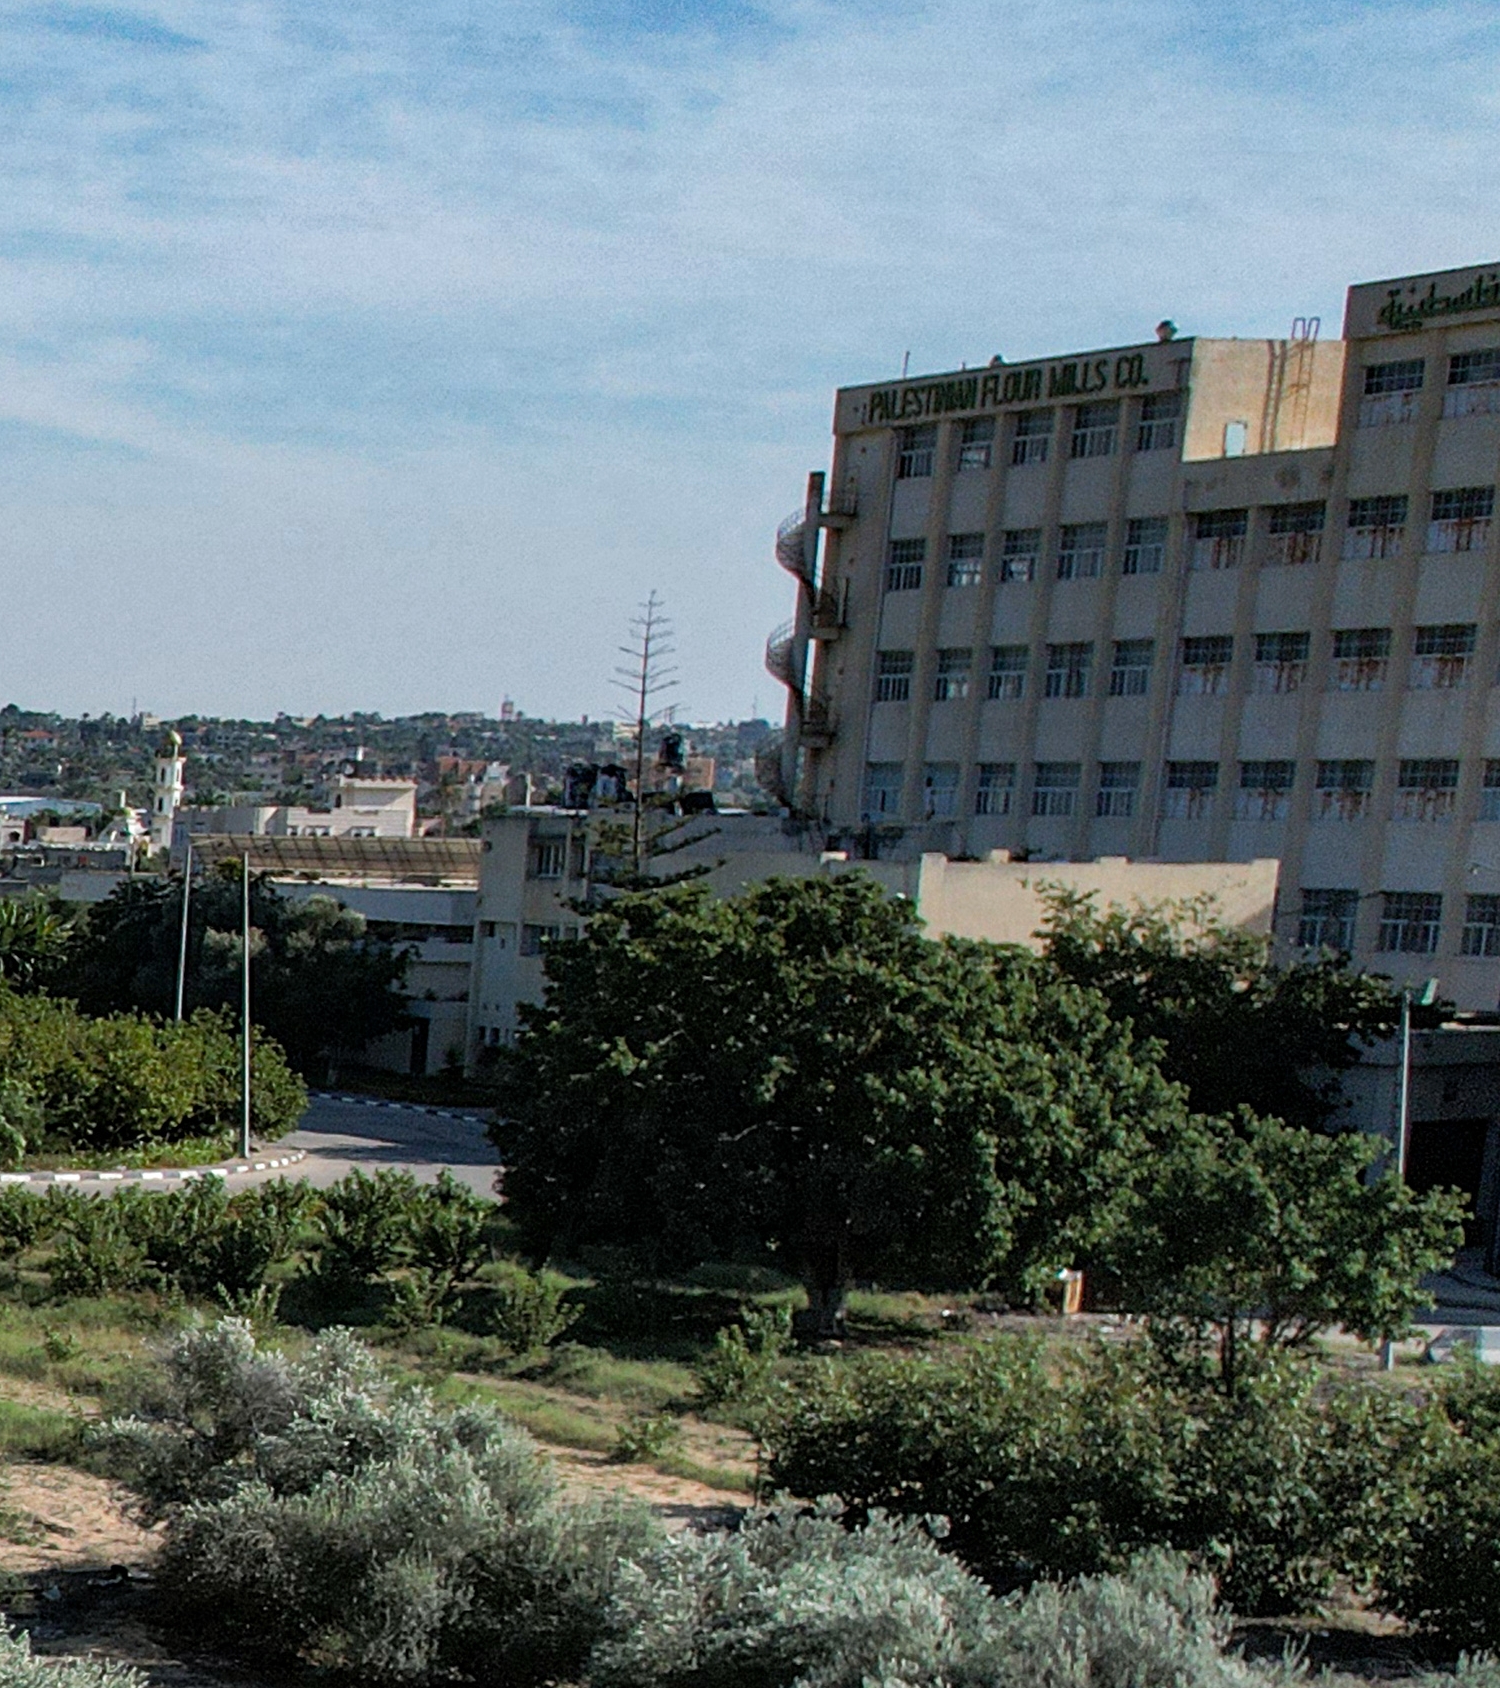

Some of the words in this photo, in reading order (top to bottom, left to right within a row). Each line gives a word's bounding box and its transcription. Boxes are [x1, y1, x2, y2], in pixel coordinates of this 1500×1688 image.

[868, 377, 978, 423] PALESTINIAN
[980, 368, 1042, 407] FLOUR
[1048, 357, 1108, 398] MILLS
[1114, 352, 1149, 388] CO.
